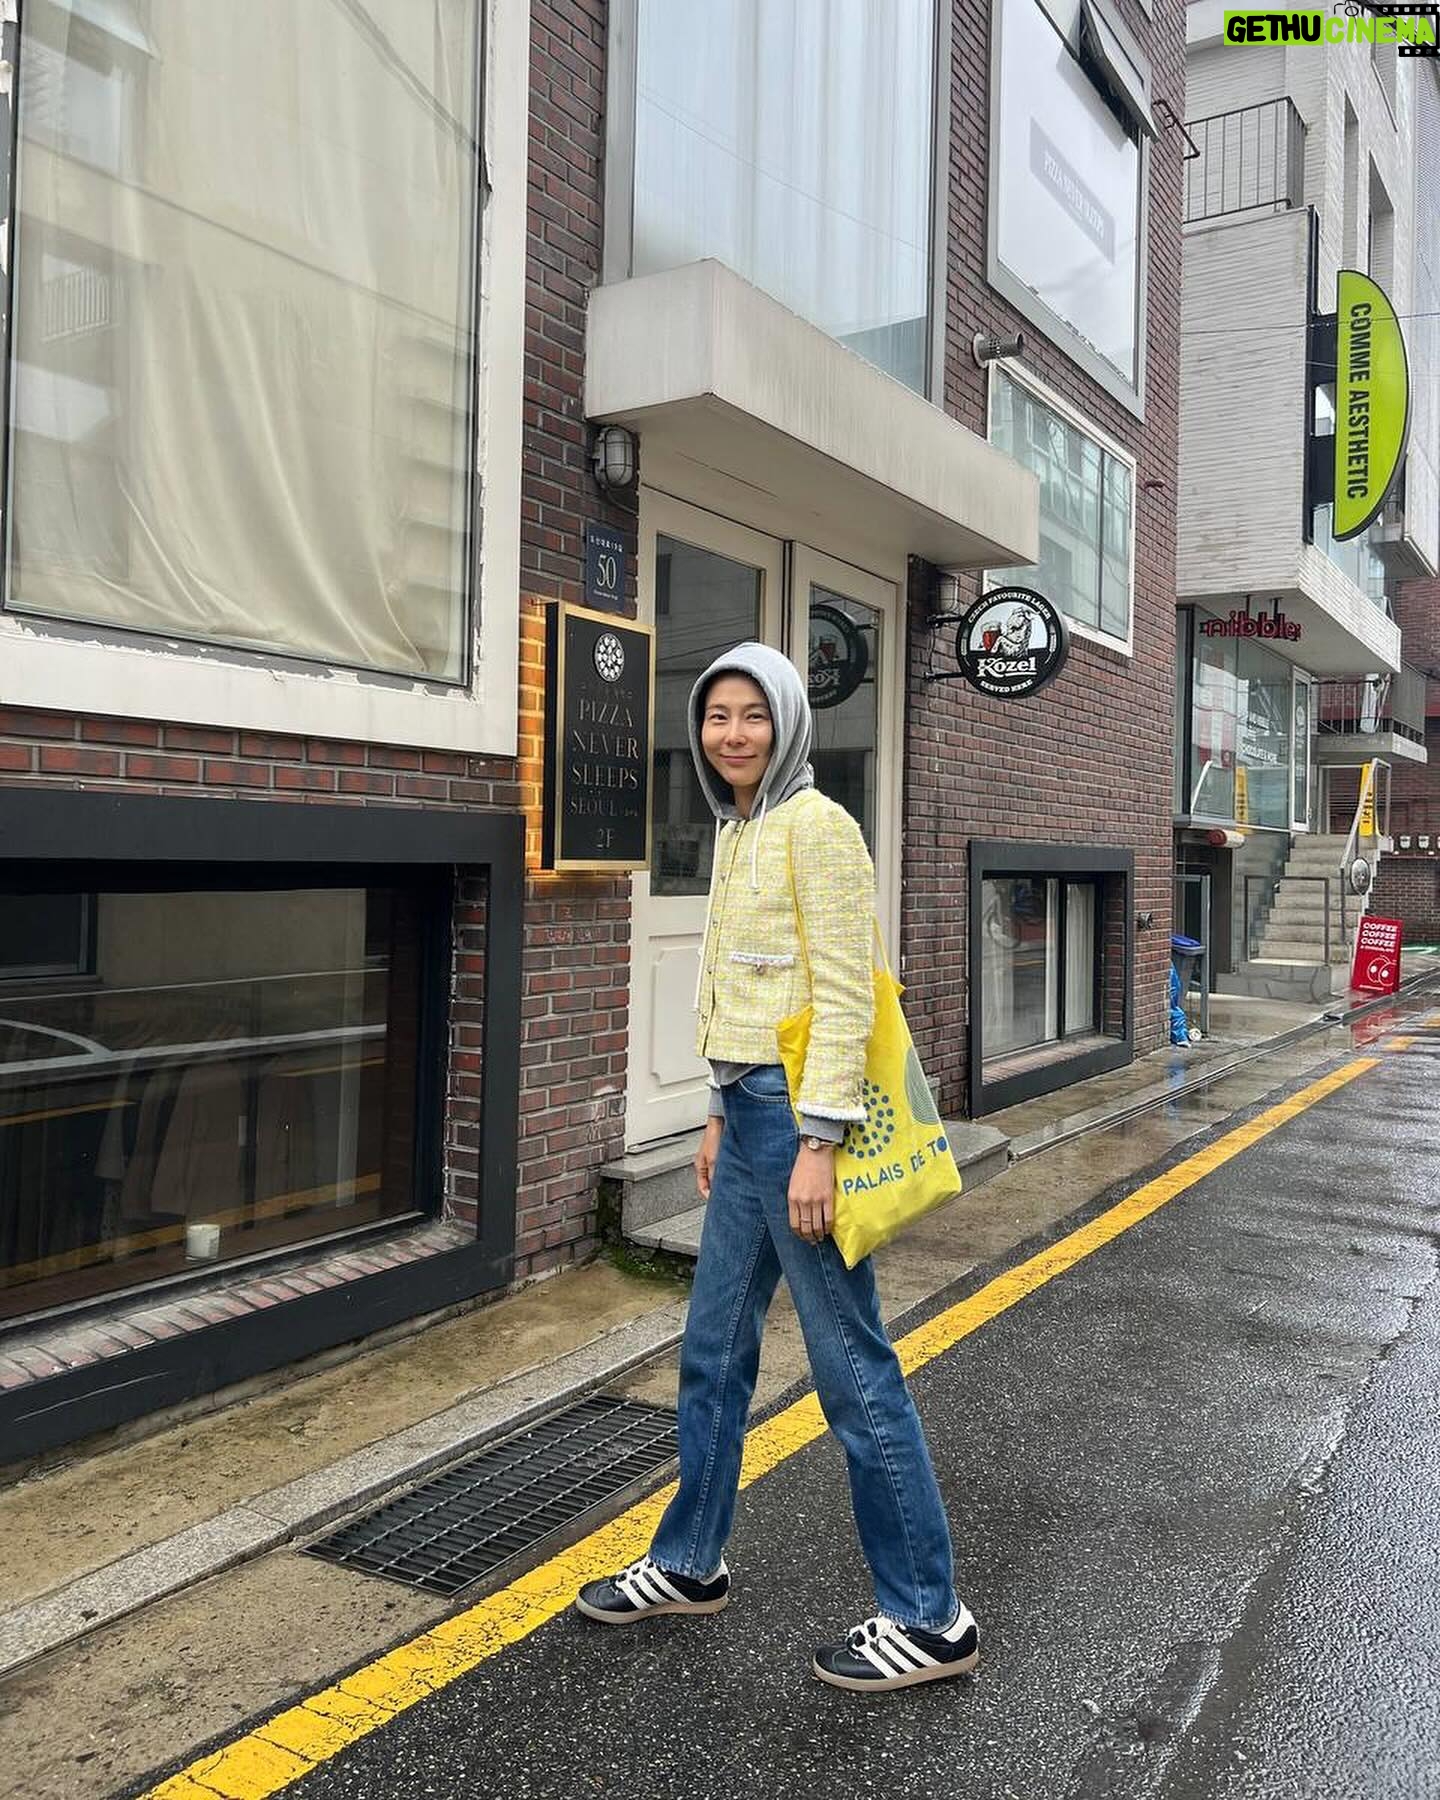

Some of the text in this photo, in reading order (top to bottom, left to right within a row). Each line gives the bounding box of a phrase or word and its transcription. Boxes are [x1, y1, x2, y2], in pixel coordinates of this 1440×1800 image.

[1347, 302, 1372, 500] COMME AESTHETIC
[596, 554, 616, 589] 50
[1031, 597, 1051, 620] LAGER
[1204, 608, 1300, 641] nibble
[977, 657, 1037, 678] Kozel
[980, 679, 1033, 692] SERVED HERE
[577, 699, 633, 728] PIZZA
[572, 729, 639, 759] NEVER
[572, 763, 639, 790] SLEEPS
[569, 799, 618, 817] SEOUL
[596, 828, 615, 848] 2F
[1362, 930, 1397, 940] COFFEE
[1363, 922, 1398, 932] COFFEE
[1361, 937, 1396, 947] COFFEE
[843, 1163, 904, 1196] PALAIS
[910, 1149, 926, 1172] DE
